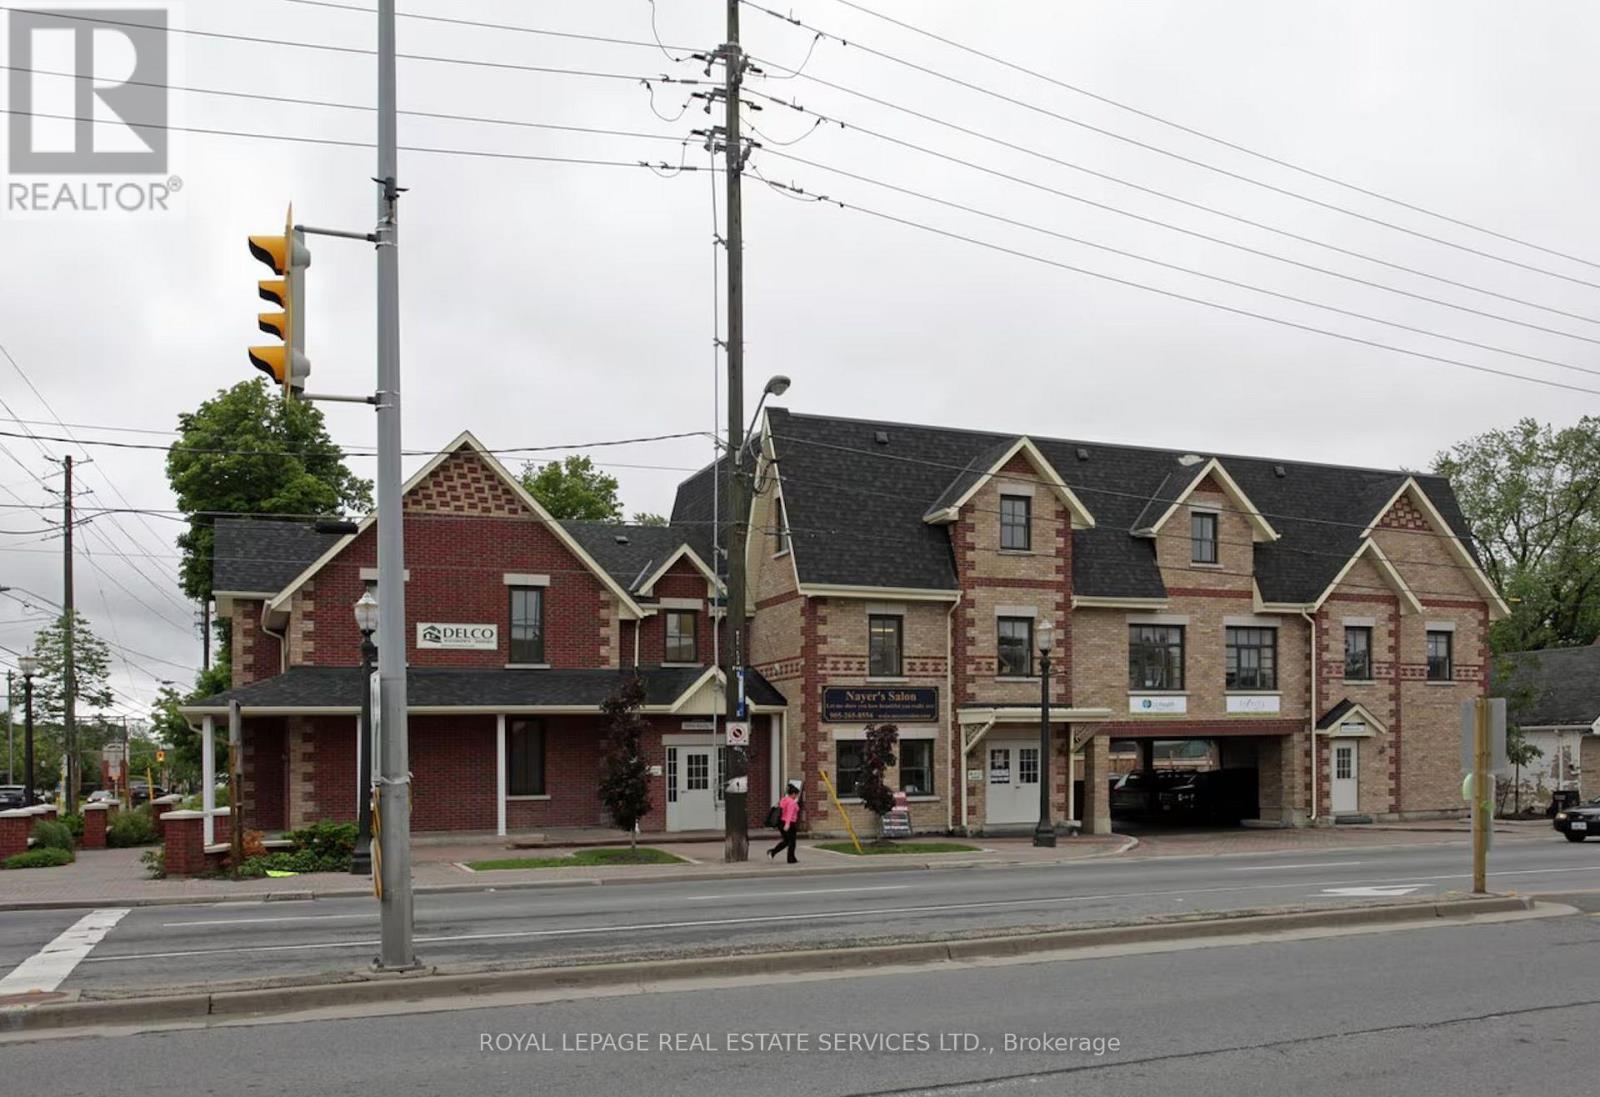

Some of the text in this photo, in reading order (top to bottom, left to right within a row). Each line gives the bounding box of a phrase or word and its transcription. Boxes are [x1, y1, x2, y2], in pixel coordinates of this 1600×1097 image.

[443, 628, 494, 639] DELCO
[846, 691, 917, 703] Nayer's Salon
